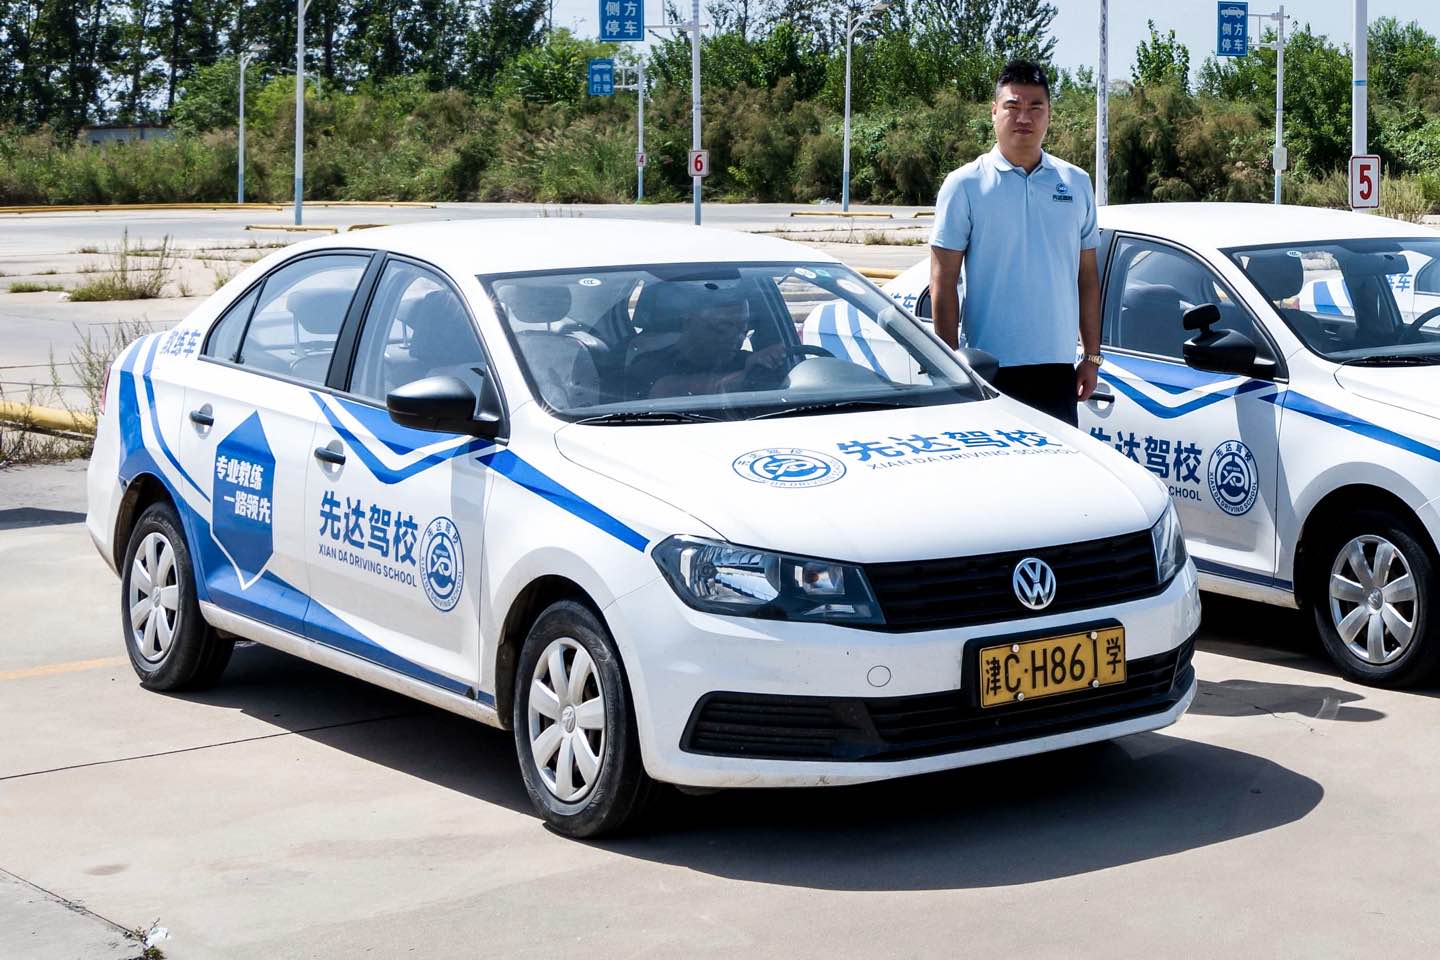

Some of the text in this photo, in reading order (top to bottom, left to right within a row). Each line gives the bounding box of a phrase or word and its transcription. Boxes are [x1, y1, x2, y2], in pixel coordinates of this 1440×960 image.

[605, 1, 638, 16] 侧方
[605, 20, 638, 36] 停车
[694, 154, 703, 172] 6
[1359, 164, 1373, 200] 5
[836, 430, 1063, 462] 先达驾校
[939, 450, 1009, 462] DRIVING
[215, 455, 264, 491] 专业教练
[223, 491, 271, 524] 一路领先
[1168, 486, 1202, 501] CHOOL
[319, 491, 418, 567] 先达驾校
[319, 544, 418, 588] XIAN DA DRIVING SCHOOL
[986, 637, 1122, 696] 津C·H861学
